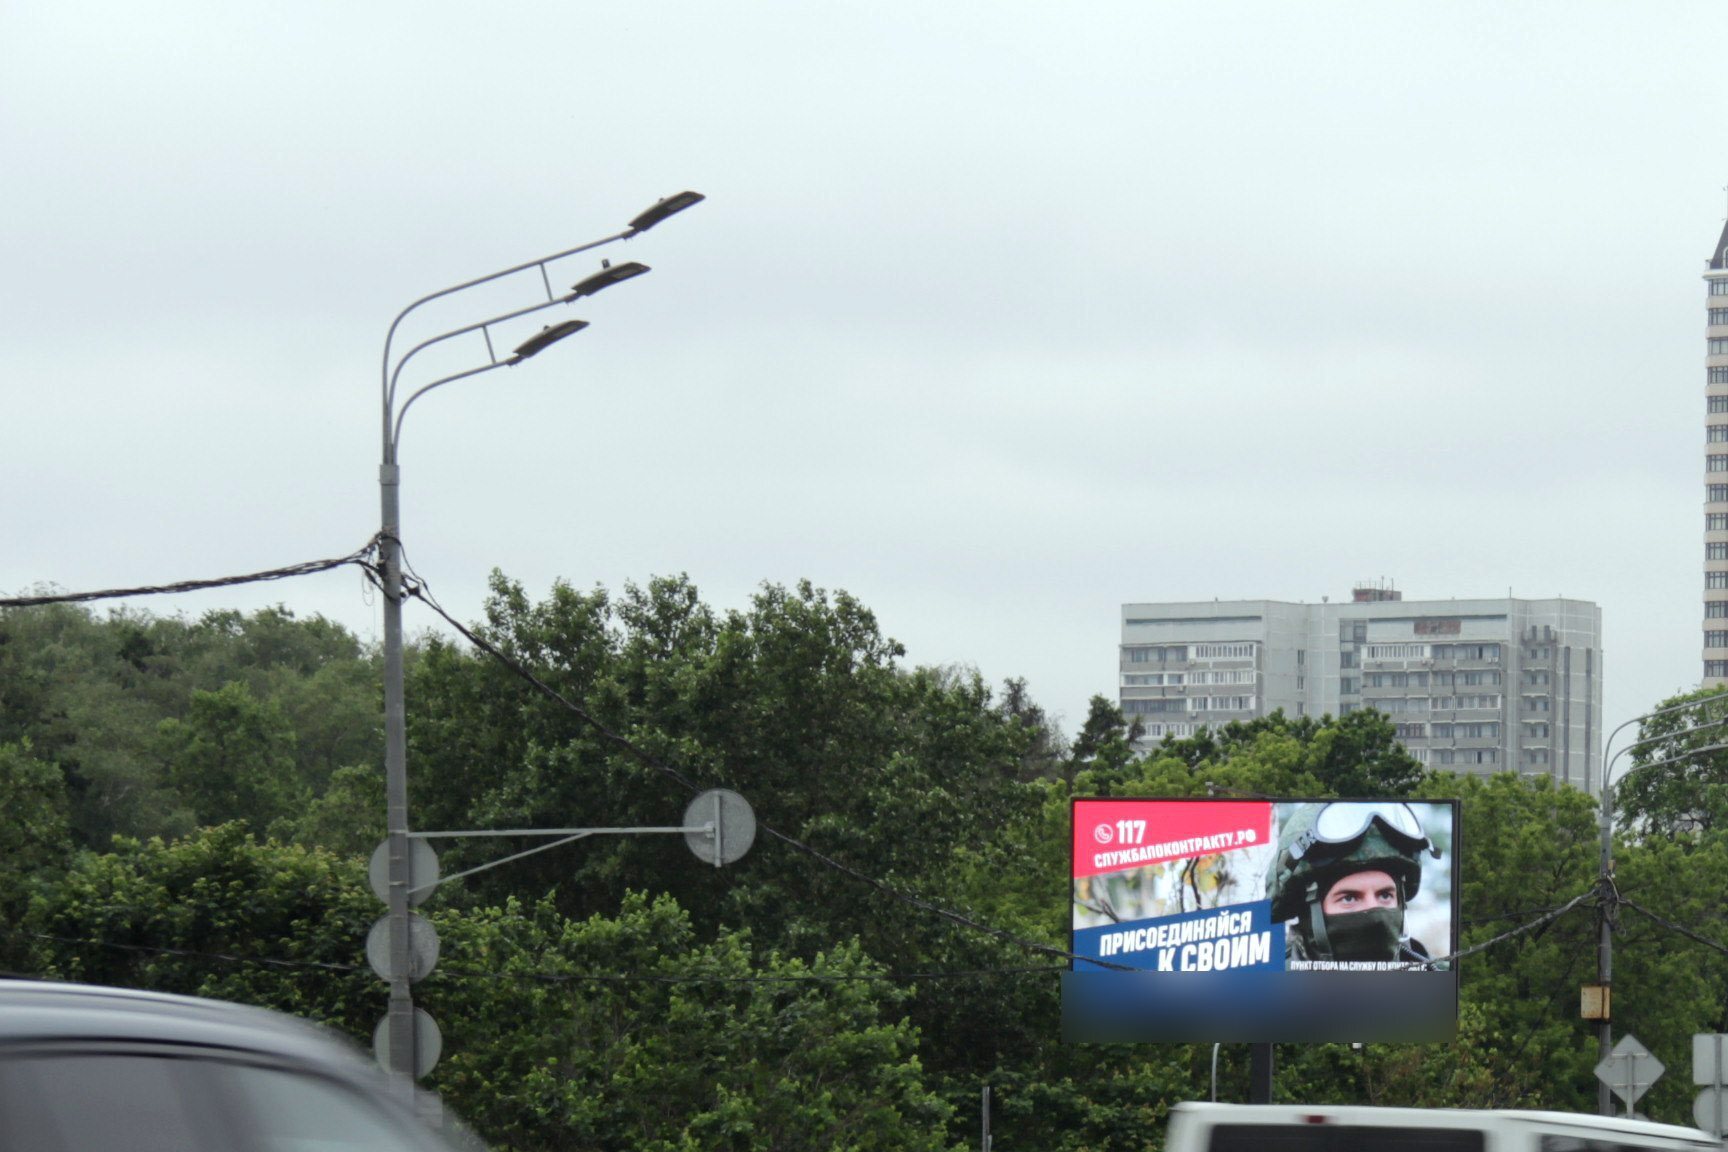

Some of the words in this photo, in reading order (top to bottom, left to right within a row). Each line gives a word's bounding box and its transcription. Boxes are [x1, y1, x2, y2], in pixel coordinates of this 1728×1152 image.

[1094, 829, 1256, 868] СЛУЖБАПОКОНТРАКТУ.РФ
[1116, 820, 1146, 844] 117
[1099, 910, 1252, 957] ПРИСОЕДИНЯЙСЯ
[1158, 948, 1177, 971] К
[1180, 931, 1271, 971] СВОИМ
[1290, 961, 1312, 971] ПУНКТ
[1313, 961, 1338, 971] ОТБОРА
[1340, 961, 1349, 971] НА
[1349, 961, 1376, 971] СЛУЖБУ
[1377, 961, 1387, 971] ПО
